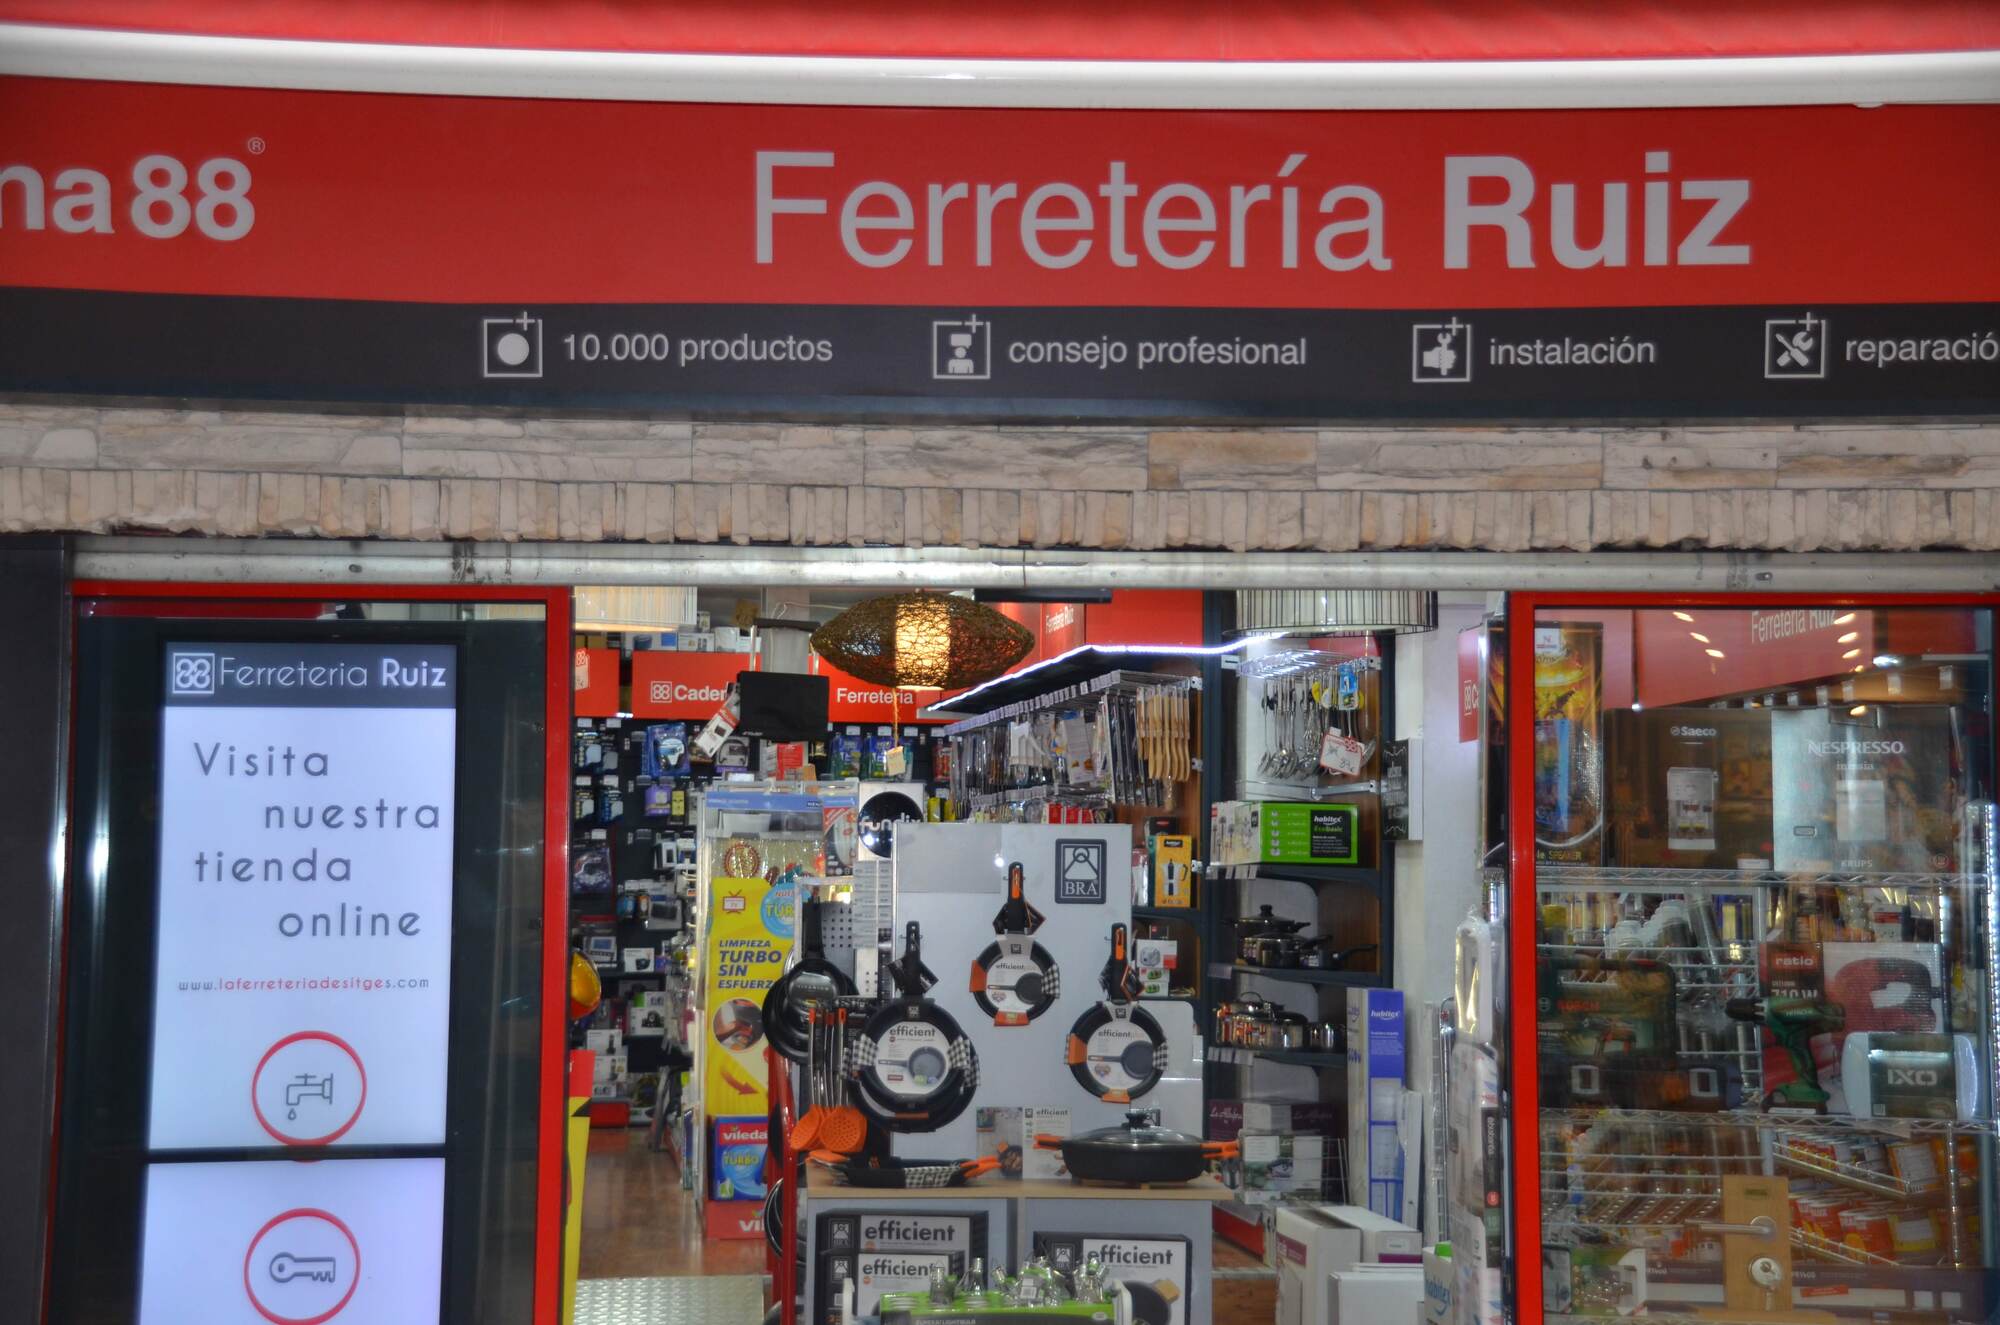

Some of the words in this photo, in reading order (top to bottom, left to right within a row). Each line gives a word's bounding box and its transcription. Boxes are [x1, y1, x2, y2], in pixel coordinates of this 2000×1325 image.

[755, 151, 1392, 272] Ferretería
[1443, 151, 1750, 269] Ruiz
[562, 334, 669, 361] 10.000
[679, 333, 833, 366] productos
[1008, 337, 1128, 370] consejo
[1136, 337, 1307, 369] profesional
[1489, 336, 1656, 365] instalación
[1845, 331, 2000, 367] reparació
[220, 657, 368, 687] Ferreteria
[381, 658, 447, 688] Ruiz
[1680, 726, 1717, 736] Saeco
[1808, 740, 1904, 756] NESPRESSO
[193, 742, 330, 777] Visita
[264, 797, 441, 830] nuestra
[194, 847, 352, 883] tienda
[1064, 881, 1098, 896] BRA
[277, 902, 422, 938] online
[718, 939, 772, 949] LIMPIEZA
[719, 950, 783, 964] TURBO
[1775, 956, 1815, 966] ratio
[718, 964, 749, 977] SIN
[177, 975, 430, 992] www.laferreteriadesitges.com
[889, 1024, 936, 1037] efficient
[1887, 1068, 1938, 1086] IXO
[722, 1127, 768, 1140] vileda
[864, 1219, 956, 1242] efficient
[1086, 1244, 1174, 1266] efficient
